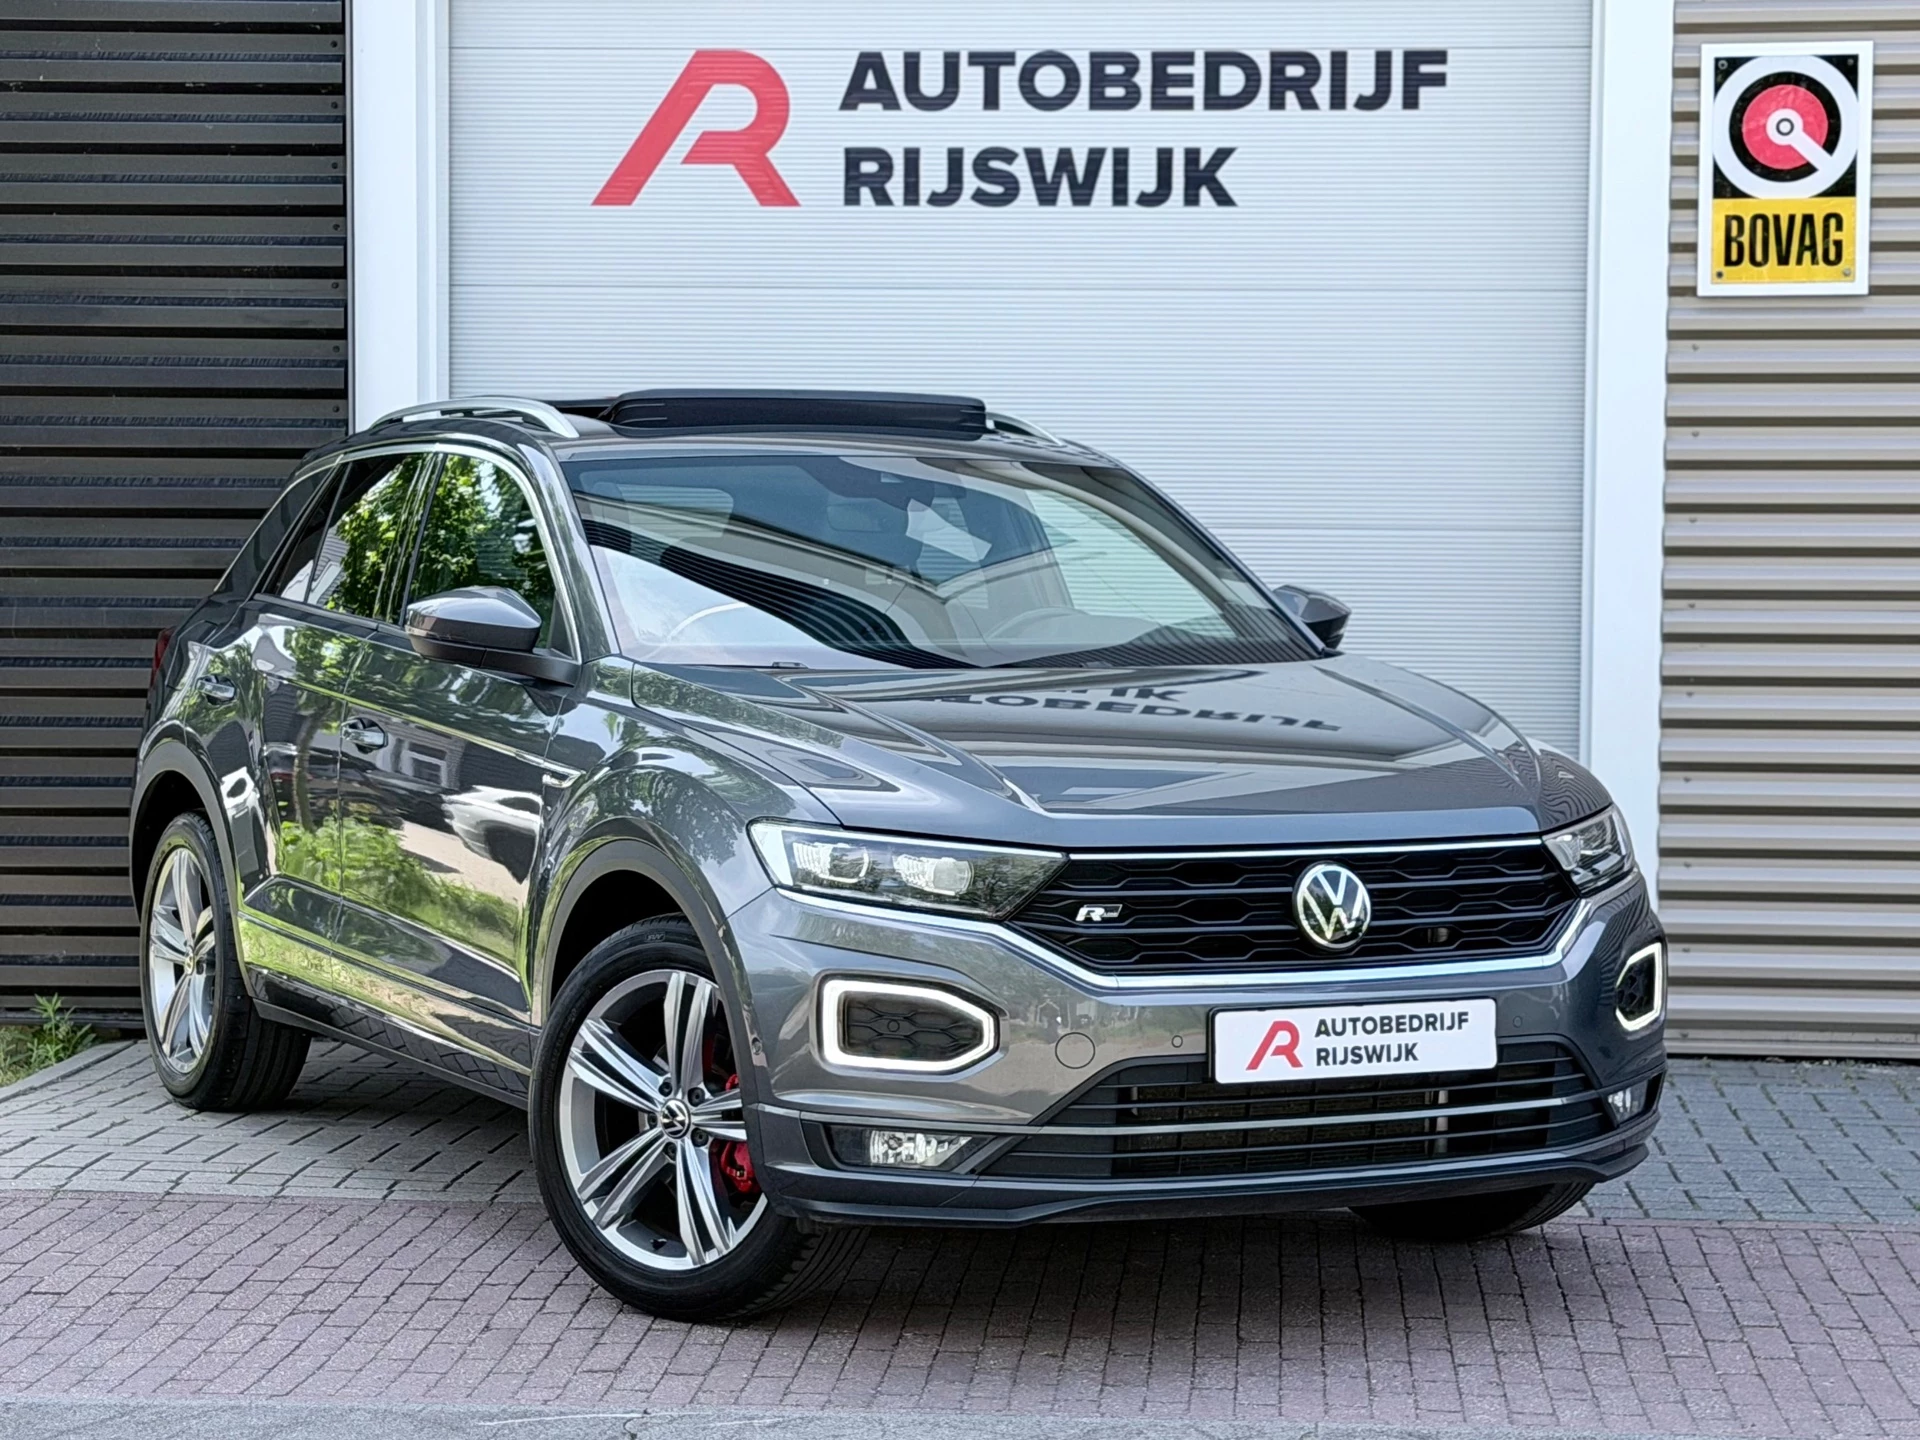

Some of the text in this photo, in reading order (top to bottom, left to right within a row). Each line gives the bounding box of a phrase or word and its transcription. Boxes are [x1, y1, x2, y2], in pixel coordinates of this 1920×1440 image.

[839, 50, 1448, 112] AUTOBEDRIJF
[844, 146, 1238, 208] RIJSWIJK
[1724, 212, 1844, 268] BOVAG
[1315, 1011, 1469, 1038] AUTOBEDRIJF
[1316, 1043, 1419, 1067] RIJSWIJK
